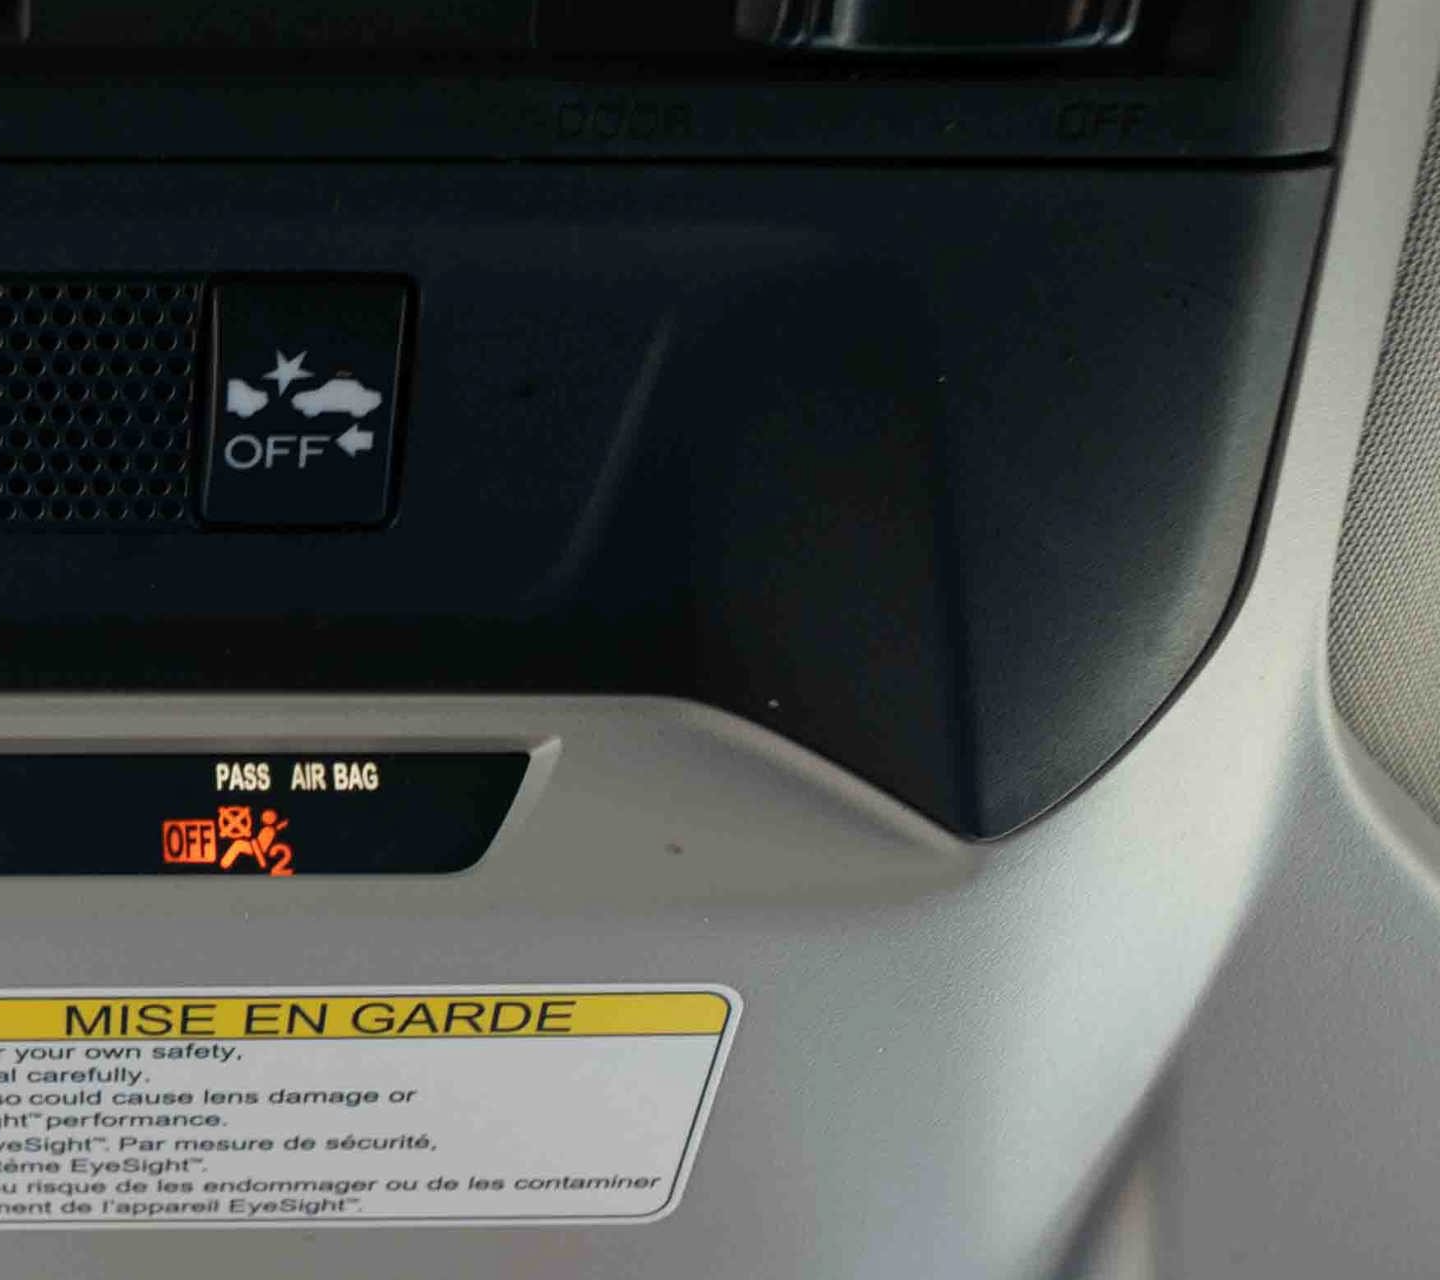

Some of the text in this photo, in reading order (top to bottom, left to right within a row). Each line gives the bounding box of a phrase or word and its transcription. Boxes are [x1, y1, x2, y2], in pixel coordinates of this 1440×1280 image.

[1056, 100, 1150, 140] OFF
[224, 434, 329, 471] OFF
[216, 762, 380, 791] PASS AIR BAG
[166, 824, 212, 858] OFF
[65, 1000, 577, 1036] MISE EN GARDE
[15, 1046, 75, 1064] your
[85, 1046, 141, 1059] own
[152, 1042, 242, 1062] safety,
[27, 1067, 150, 1086] carefully.
[29, 1090, 102, 1105] could
[112, 1092, 193, 1105] cause
[204, 1089, 259, 1104] lens
[268, 1089, 379, 1107] damage
[388, 1090, 417, 1103] or
[46, 1111, 227, 1131] performance.
[119, 1136, 165, 1151] Par
[174, 1138, 275, 1151] mesure
[283, 1135, 317, 1150] de
[325, 1133, 438, 1151] sécurité,
[27, 1179, 107, 1196] risque
[115, 1178, 148, 1193] de
[157, 1178, 193, 1193] les
[203, 1177, 377, 1195] endommager
[385, 1179, 418, 1192] ou
[427, 1176, 459, 1191] de
[468, 1176, 505, 1191] les
[514, 1174, 662, 1191] contaminer
[60, 1199, 93, 1213] de
[102, 1198, 219, 1217] l'appareil
